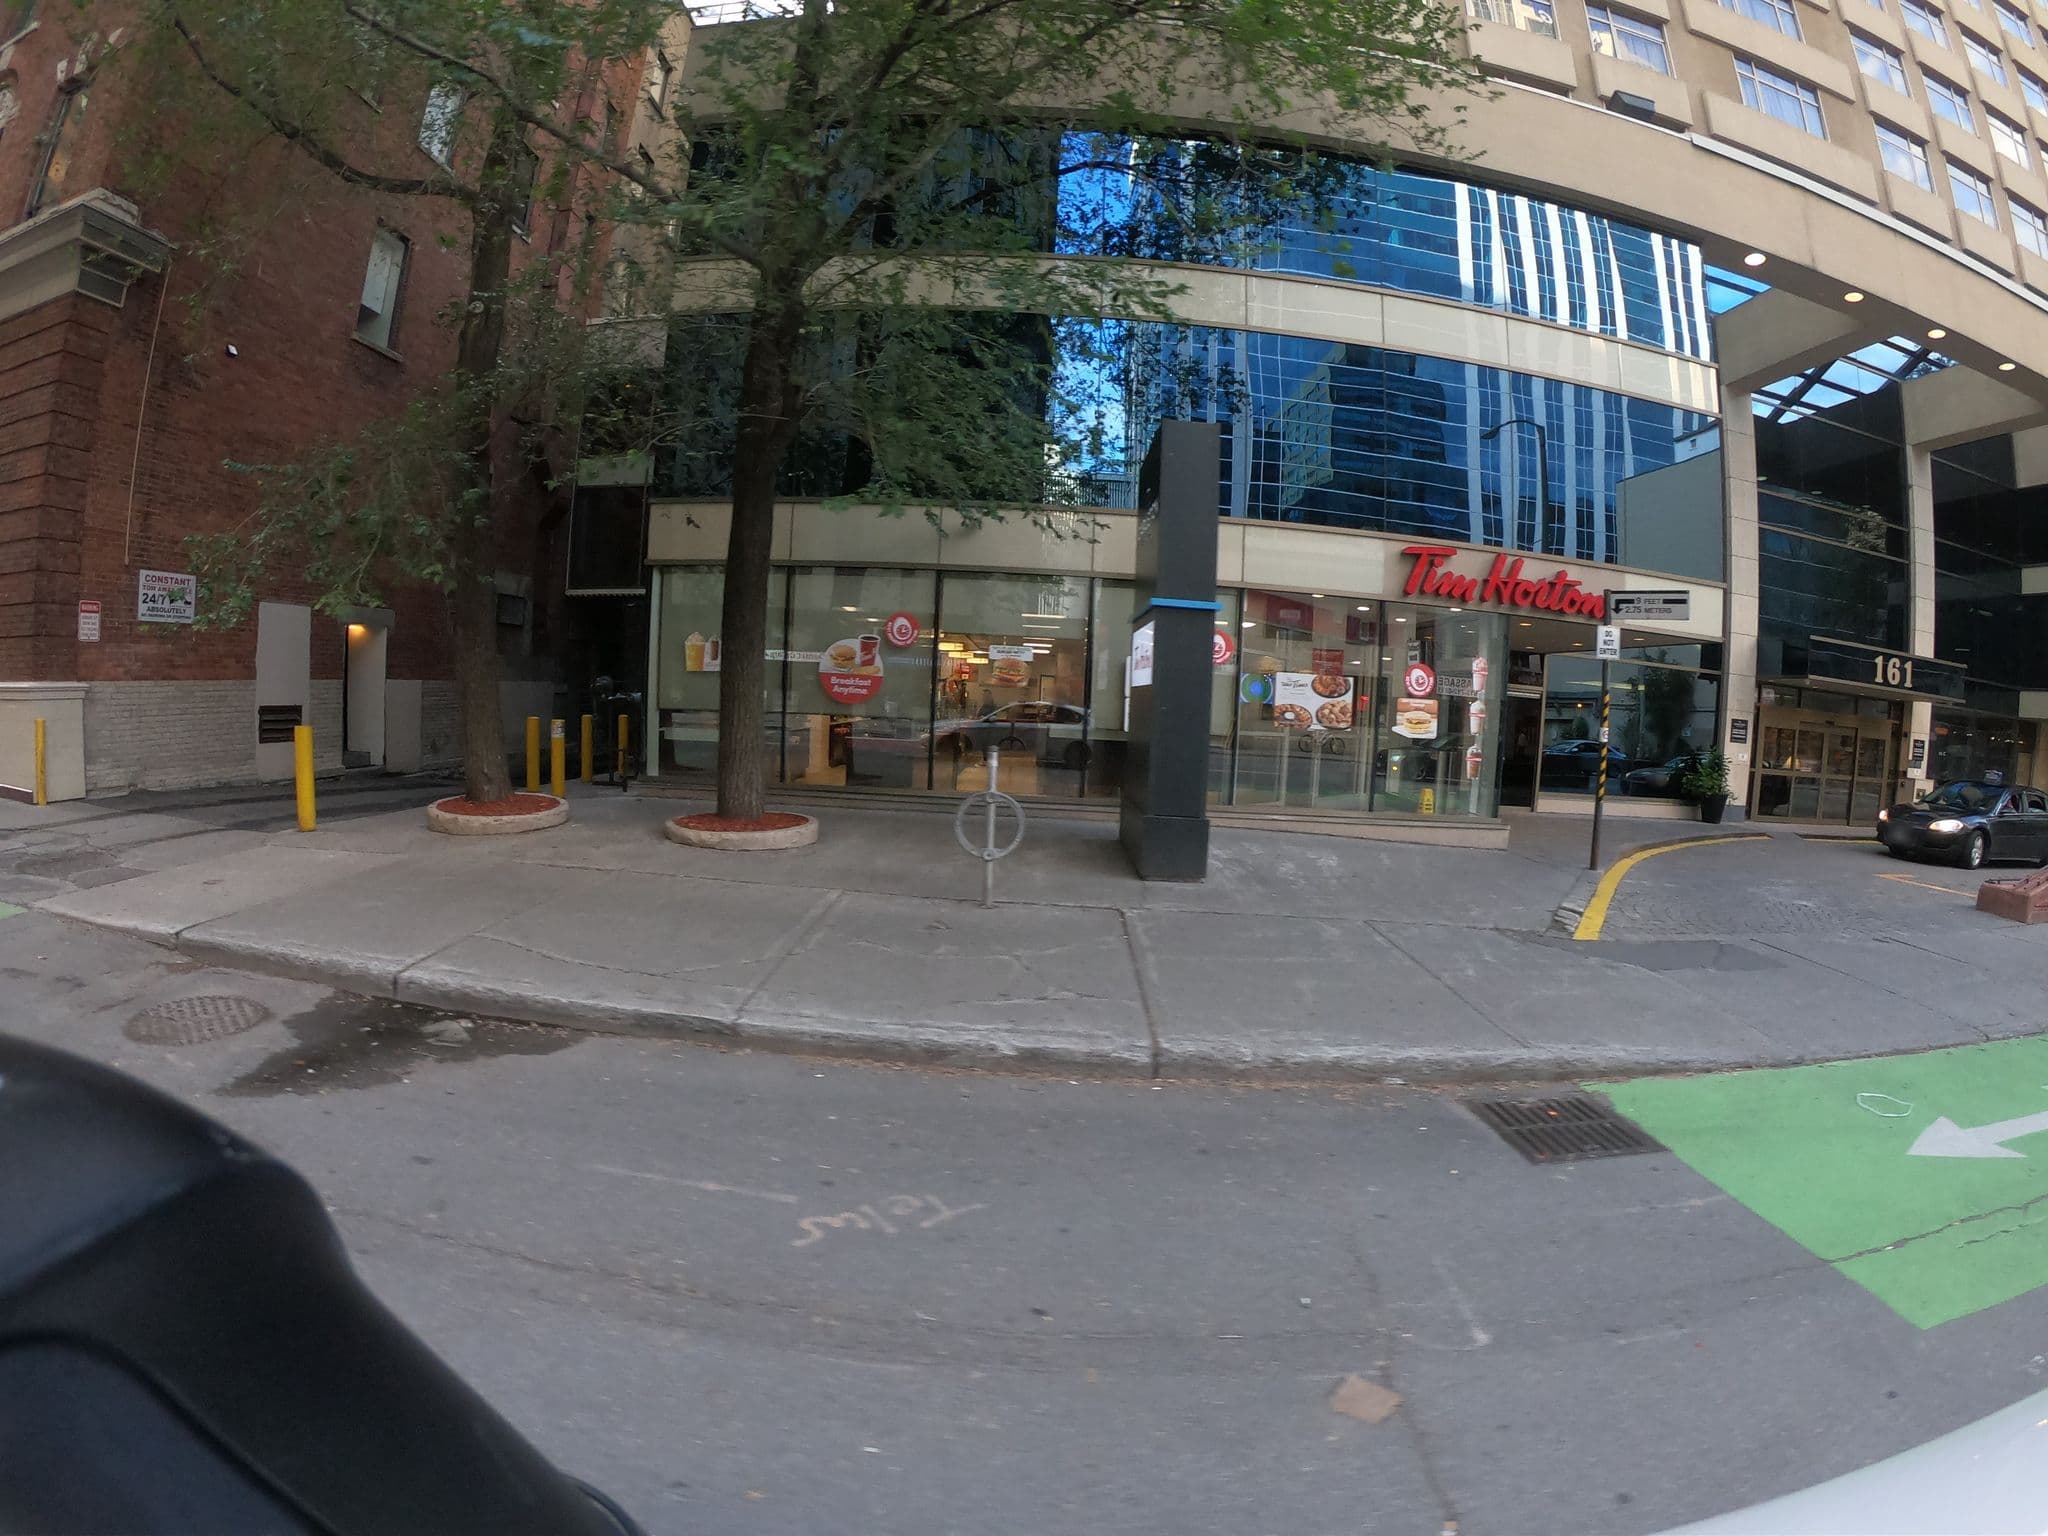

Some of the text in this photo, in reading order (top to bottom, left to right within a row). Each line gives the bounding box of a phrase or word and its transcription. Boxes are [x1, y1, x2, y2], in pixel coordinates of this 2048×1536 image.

[144, 574, 192, 586] CONSTANT
[1403, 546, 1606, 618] Tim Horton
[142, 592, 167, 605] 24/7
[146, 606, 187, 614] ABSOLUTELY
[1625, 606, 1642, 614] 2.75
[1599, 648, 1617, 656] ENTER
[1874, 655, 1913, 688] 161
[830, 676, 872, 686] Breakfast
[832, 685, 868, 695] Anytime
